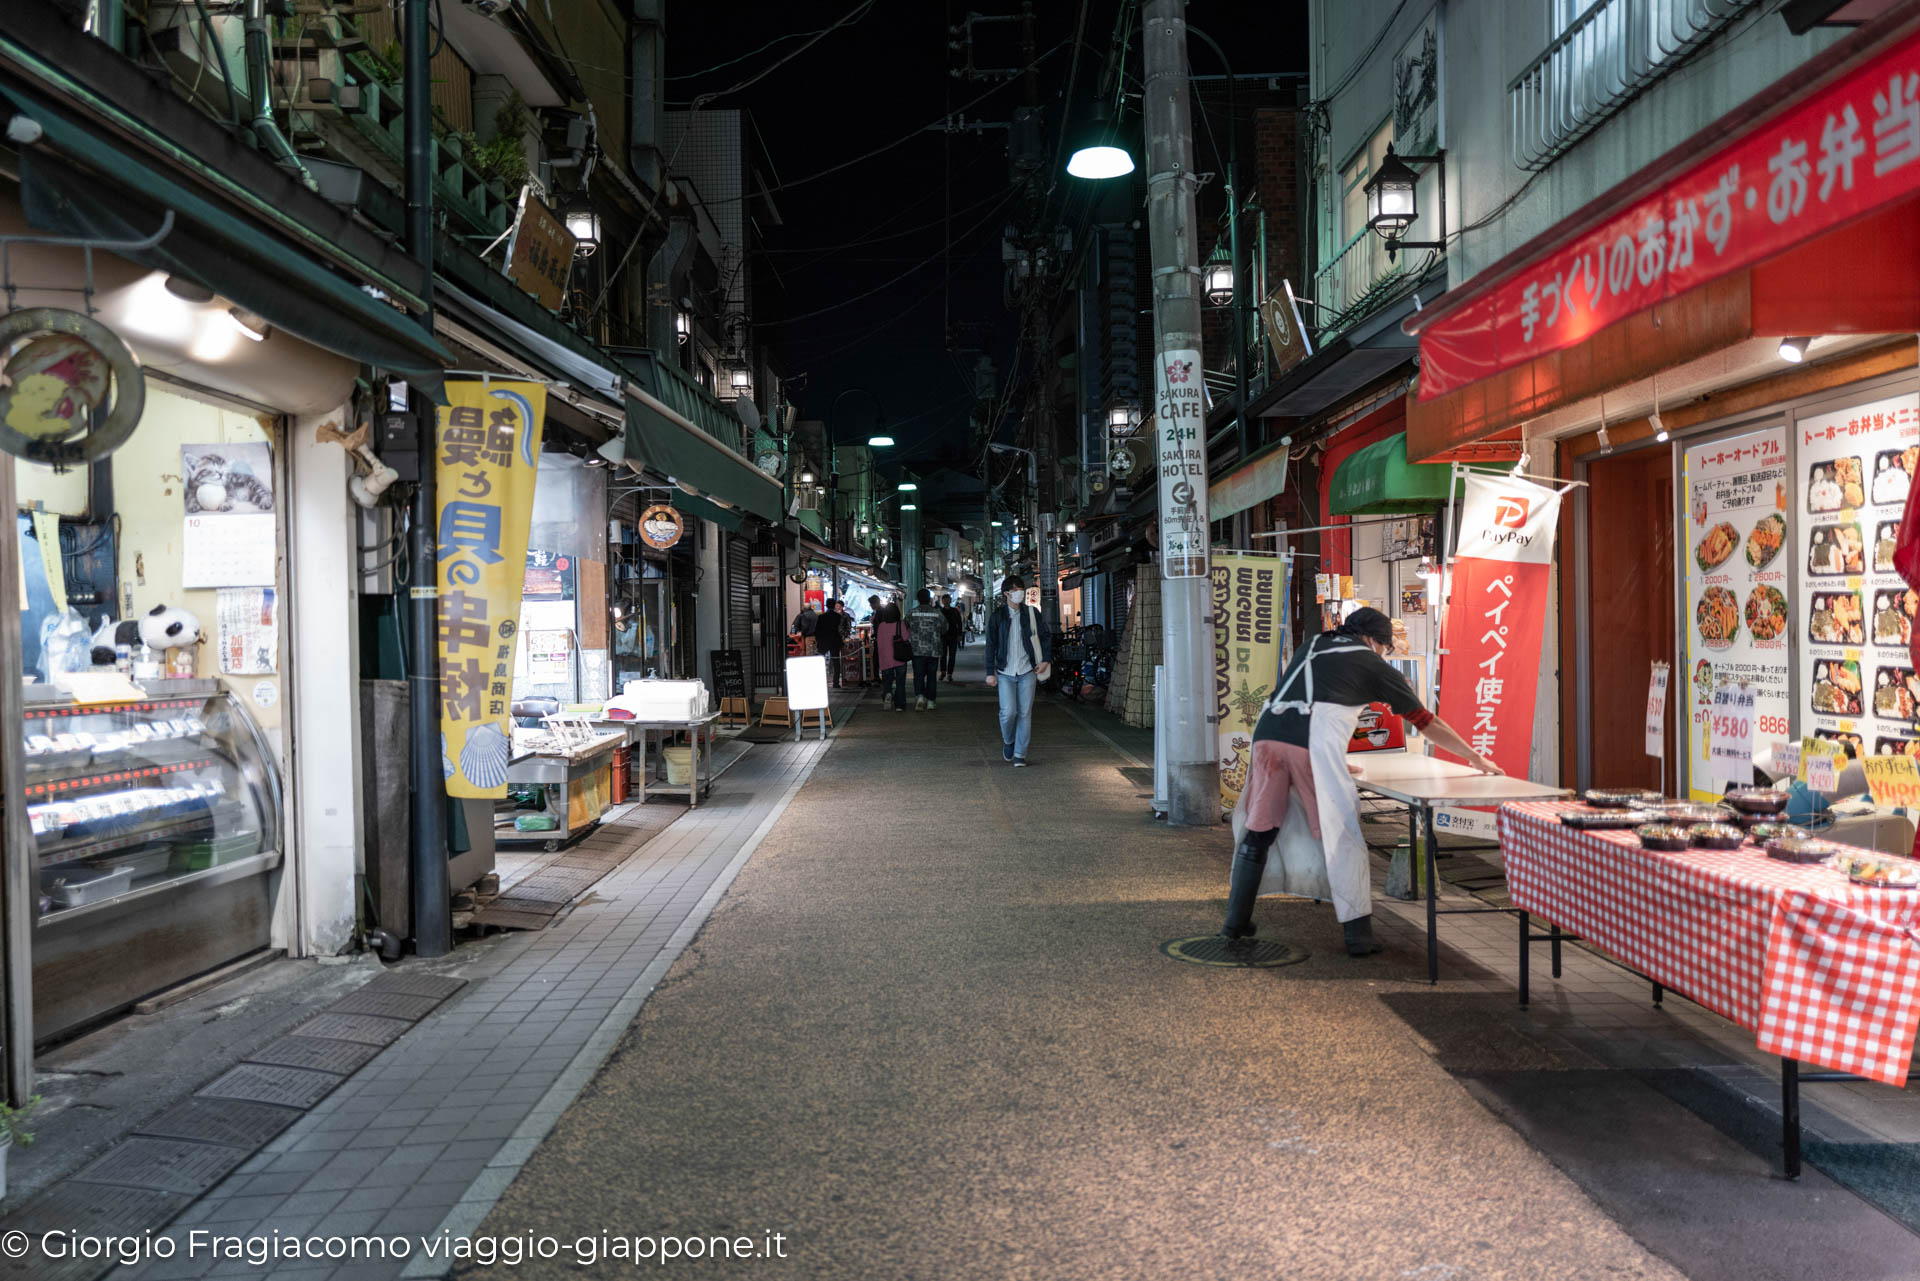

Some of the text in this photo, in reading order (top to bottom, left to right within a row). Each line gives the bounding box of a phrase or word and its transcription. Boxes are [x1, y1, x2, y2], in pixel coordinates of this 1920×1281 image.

[1160, 387, 1200, 401] SAKURA
[1160, 402, 1200, 420] CAFE
[1166, 428, 1197, 442] 24H
[1162, 449, 1202, 462] SAKURA
[1162, 463, 1203, 478] HOTEL
[1469, 574, 1514, 765] ペイペイ使えま
[1713, 715, 1749, 740] ¥580
